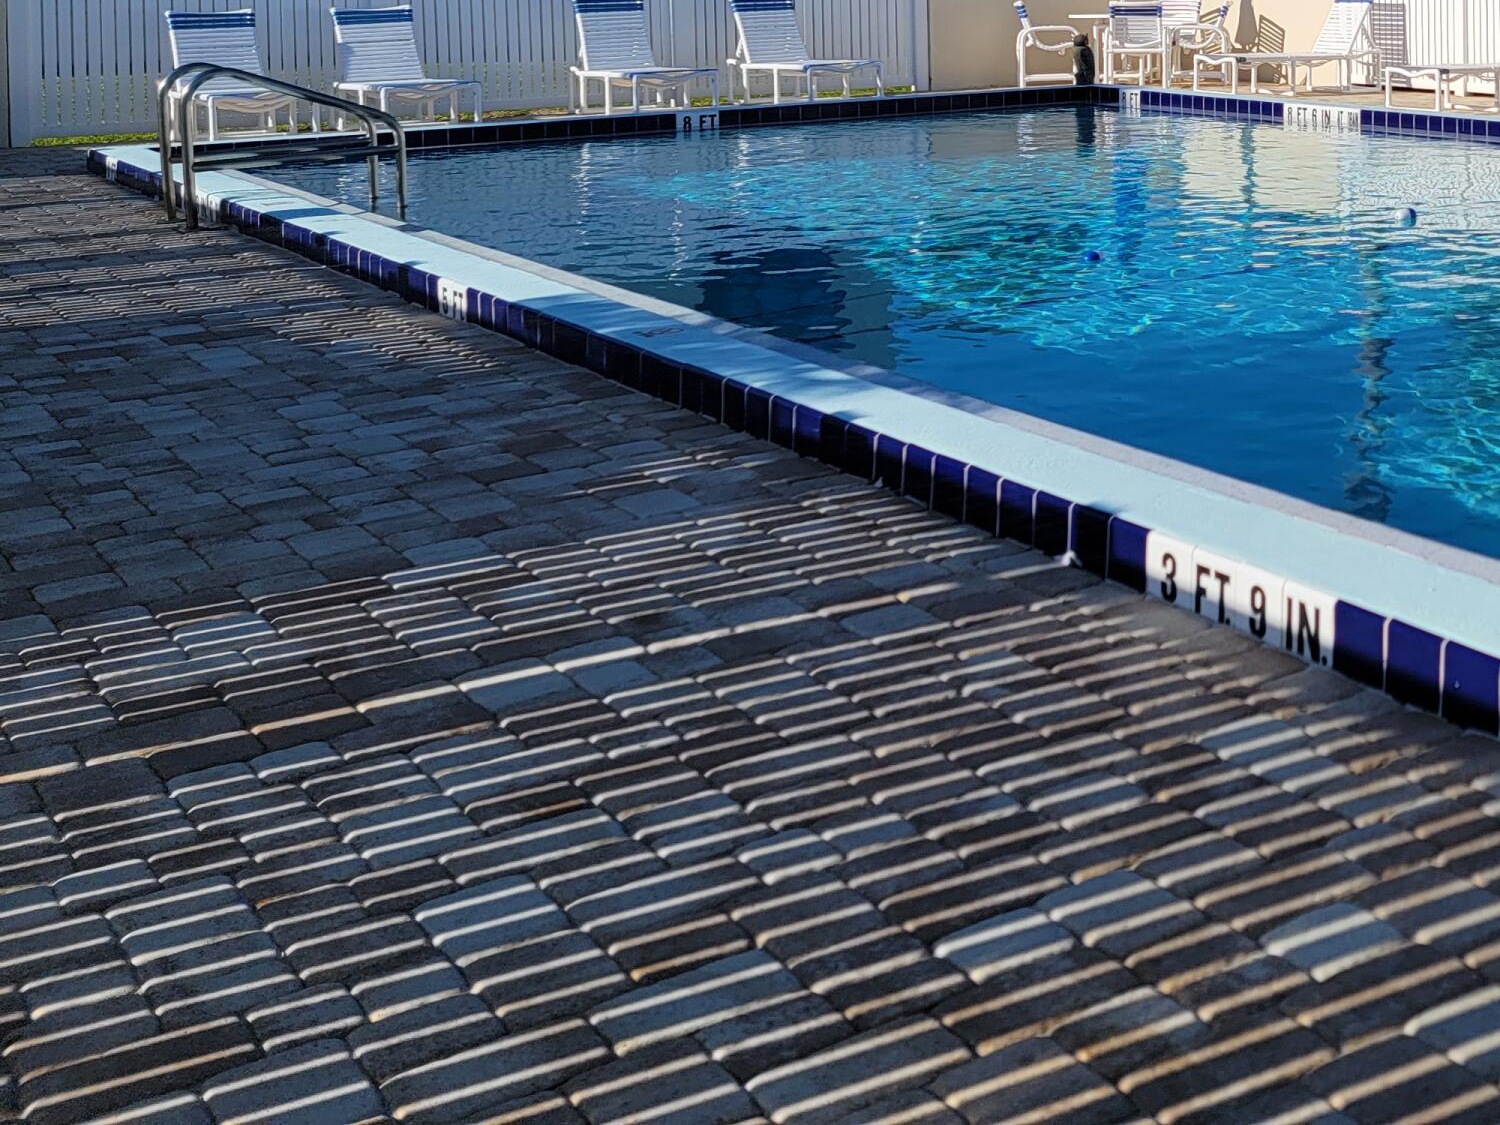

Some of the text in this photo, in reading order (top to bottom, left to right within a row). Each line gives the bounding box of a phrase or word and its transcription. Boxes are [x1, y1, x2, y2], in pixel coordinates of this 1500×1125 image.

[683, 114, 717, 132] 8 FT
[1297, 107, 1307, 127] FT
[1322, 109, 1331, 129] IN
[1160, 552, 1328, 666] 3 FT. 9 IN.
